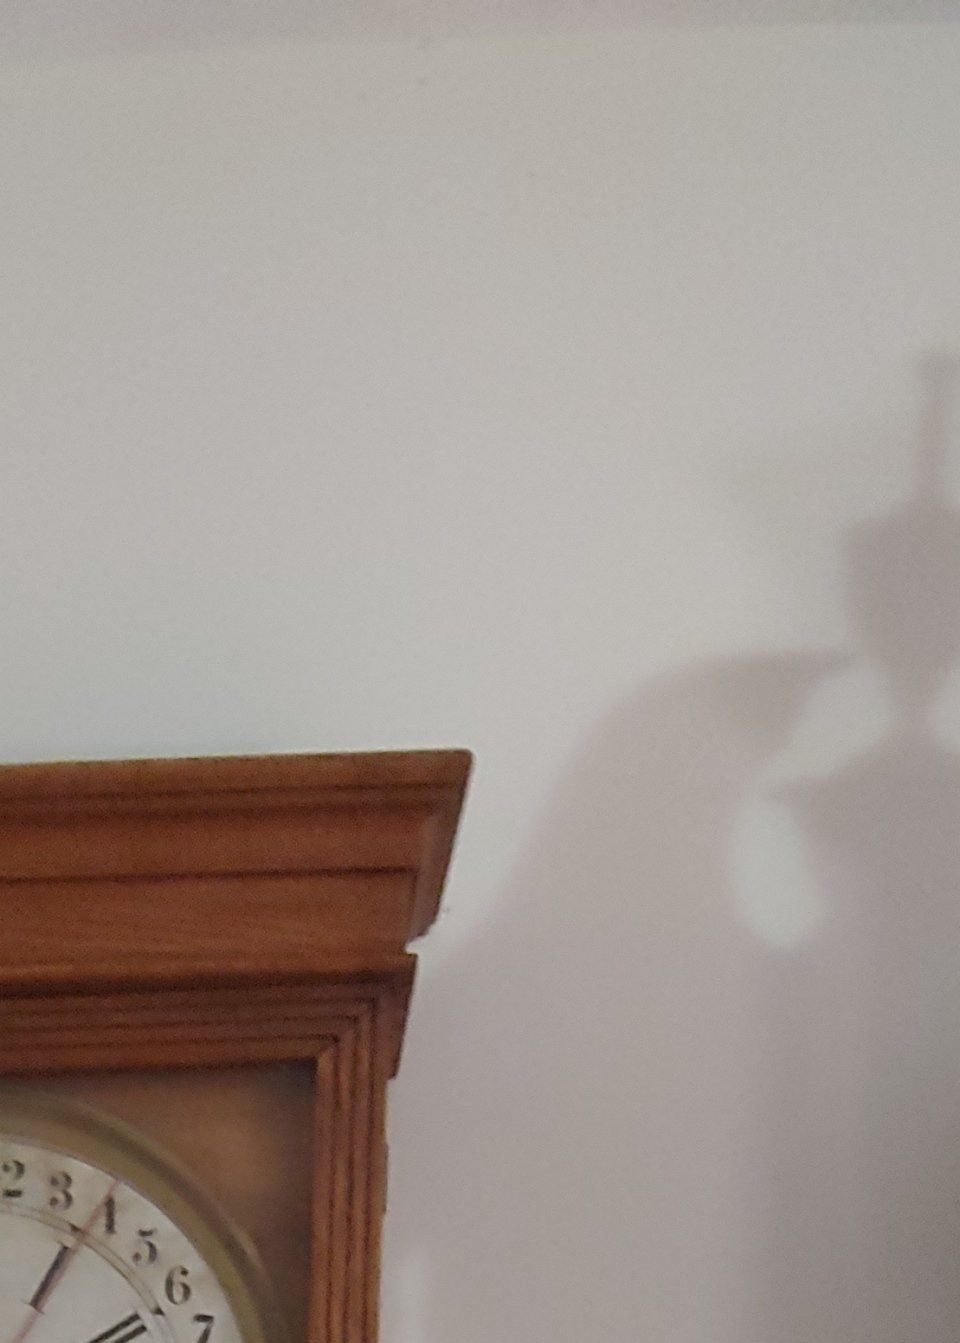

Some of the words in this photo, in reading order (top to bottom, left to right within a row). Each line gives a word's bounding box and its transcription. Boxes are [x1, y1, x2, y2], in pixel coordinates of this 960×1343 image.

[2, 1160, 25, 1197] 2
[49, 1171, 73, 1210] 3
[132, 1228, 157, 1265] 5
[165, 1266, 191, 1305] 6
